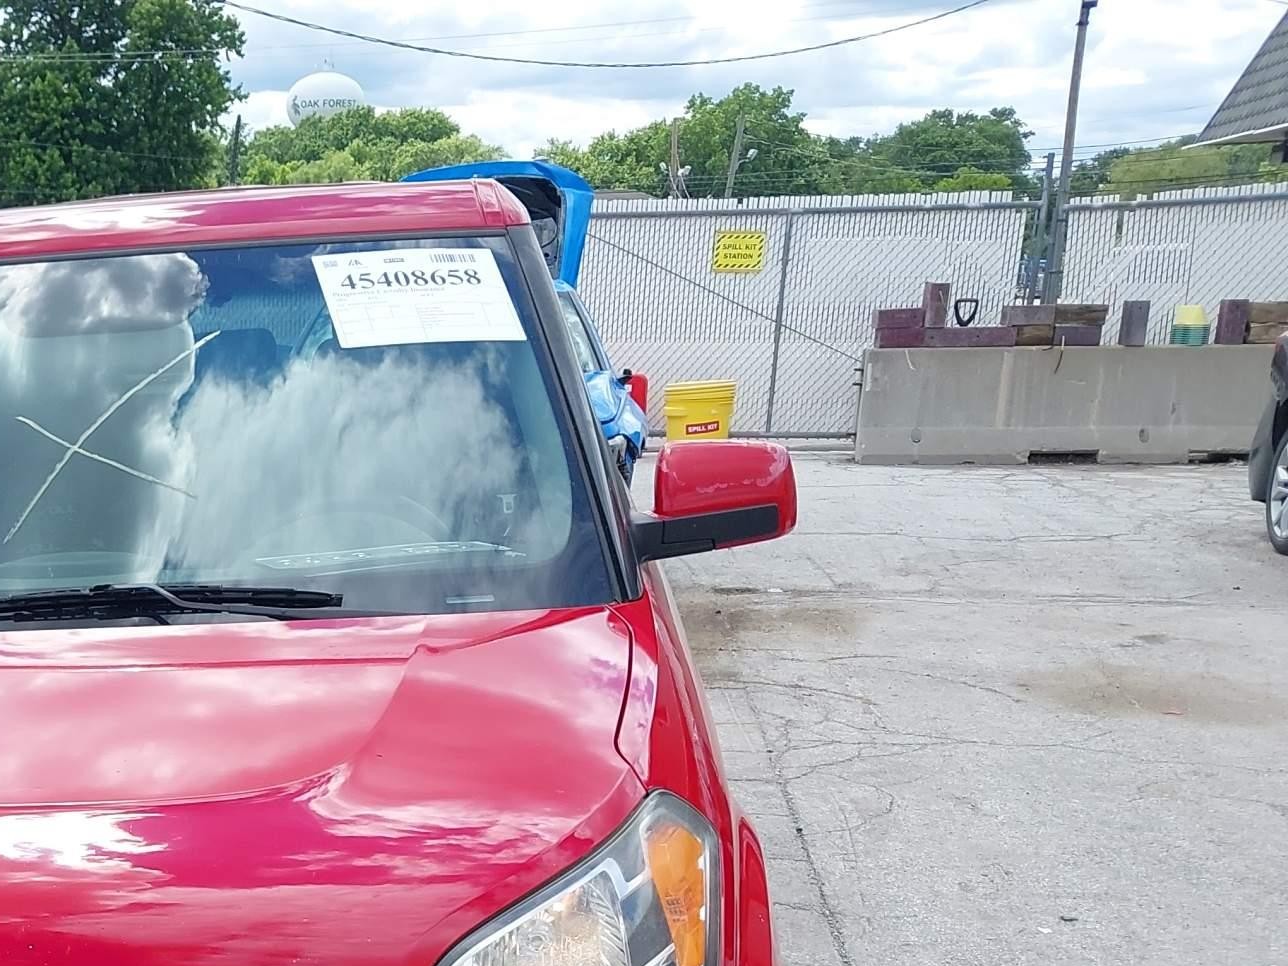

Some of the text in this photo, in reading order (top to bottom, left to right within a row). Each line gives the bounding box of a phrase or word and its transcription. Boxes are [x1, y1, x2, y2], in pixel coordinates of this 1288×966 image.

[300, 98, 357, 109] OAK FOREST
[340, 269, 482, 289] 45408658
